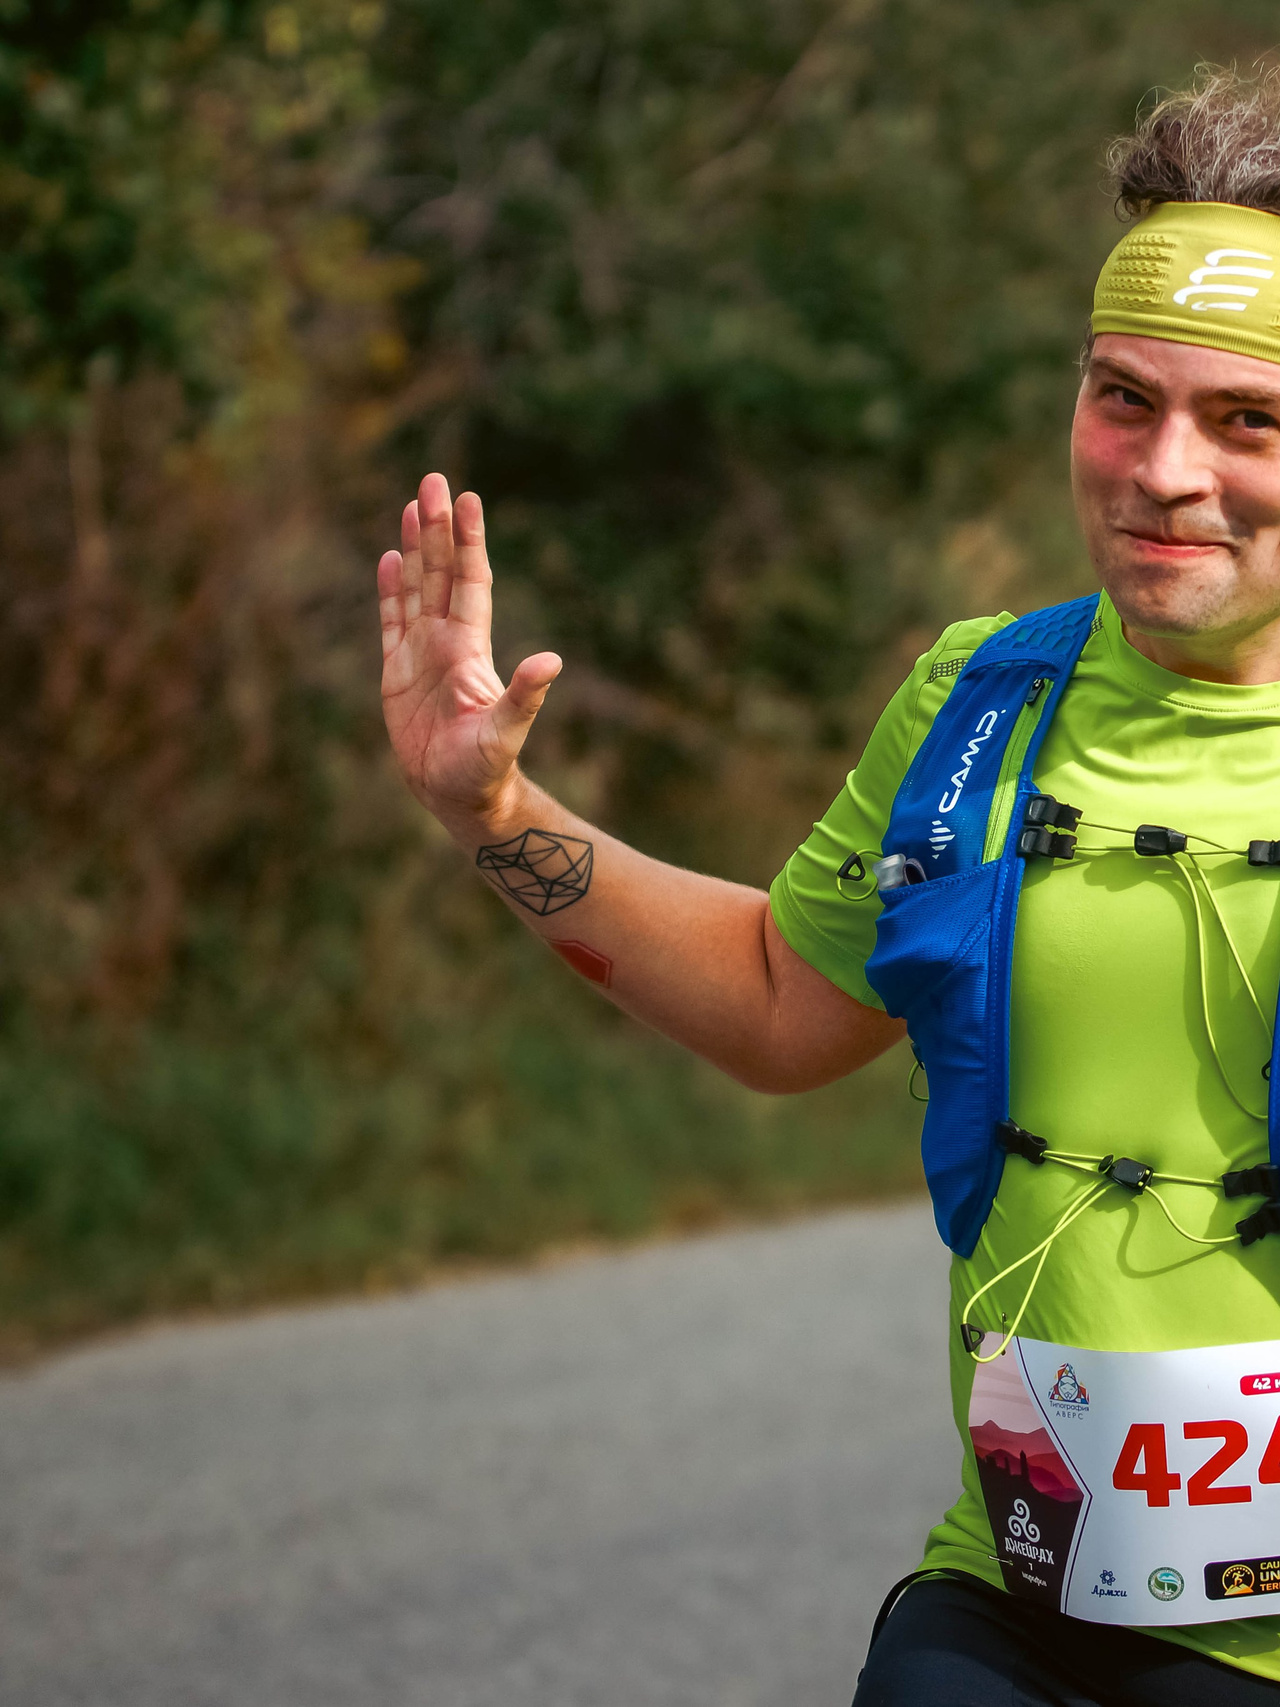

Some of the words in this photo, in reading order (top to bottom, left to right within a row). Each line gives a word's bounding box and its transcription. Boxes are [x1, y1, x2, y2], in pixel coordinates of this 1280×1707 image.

[938, 710, 998, 814] CAMP
[1252, 1377, 1272, 1390] 42
[1055, 1410, 1084, 1420] АВЕРС
[1004, 1536, 1055, 1565] ДЖЕЙРАХ
[1090, 1584, 1128, 1598] Армхи
